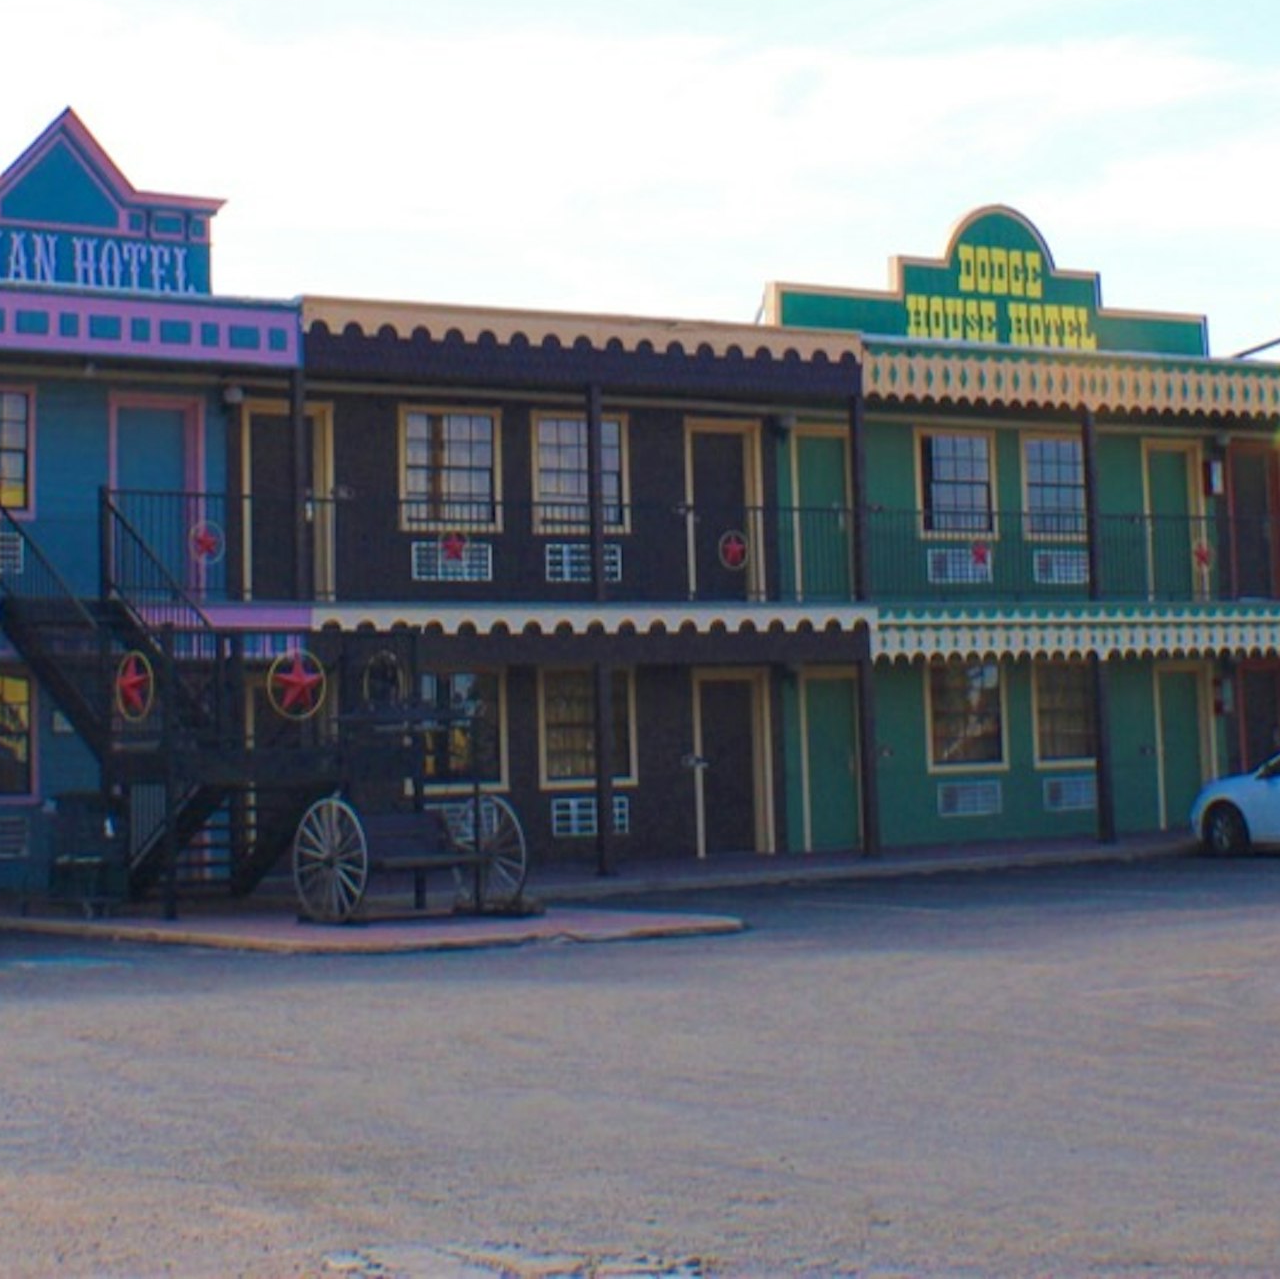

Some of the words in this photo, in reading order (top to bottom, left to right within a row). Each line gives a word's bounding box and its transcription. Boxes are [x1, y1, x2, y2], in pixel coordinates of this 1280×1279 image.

[73, 235, 197, 295] HOTEL
[958, 243, 1042, 299] DODGE
[906, 294, 998, 344] HOUSE
[1008, 301, 1097, 350] HOTEL
